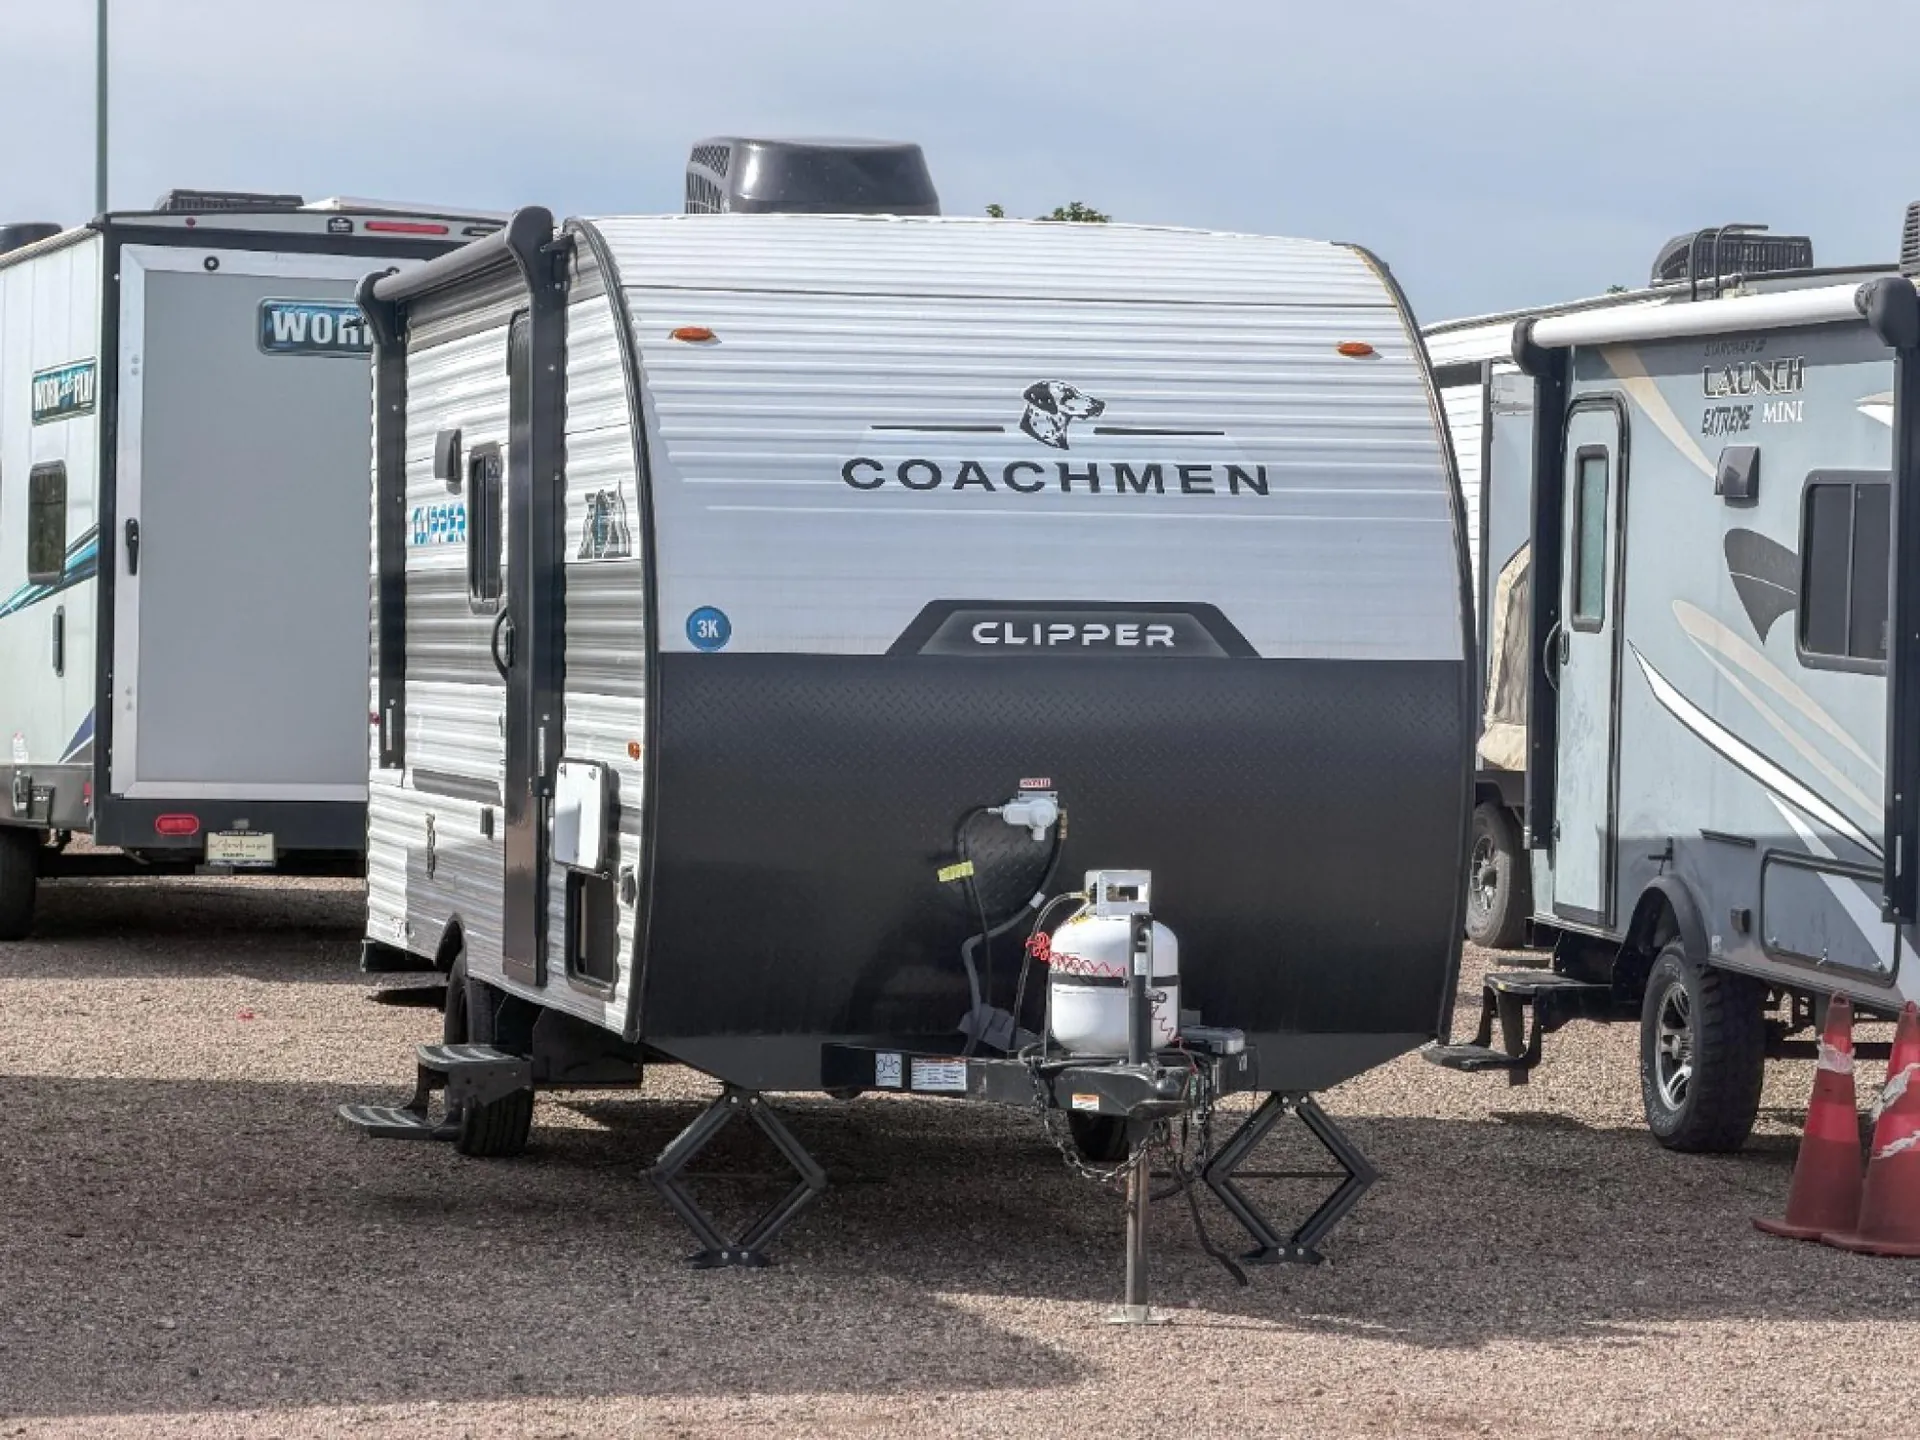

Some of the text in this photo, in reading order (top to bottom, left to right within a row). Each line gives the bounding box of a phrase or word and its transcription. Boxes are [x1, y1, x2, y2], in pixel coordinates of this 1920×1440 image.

[1702, 355, 1805, 400] LAUNCH
[1762, 400, 1804, 424] MINI
[841, 457, 1270, 496] COACHMEN
[696, 619, 719, 638] 3K
[971, 621, 1176, 647] CLIPPER
